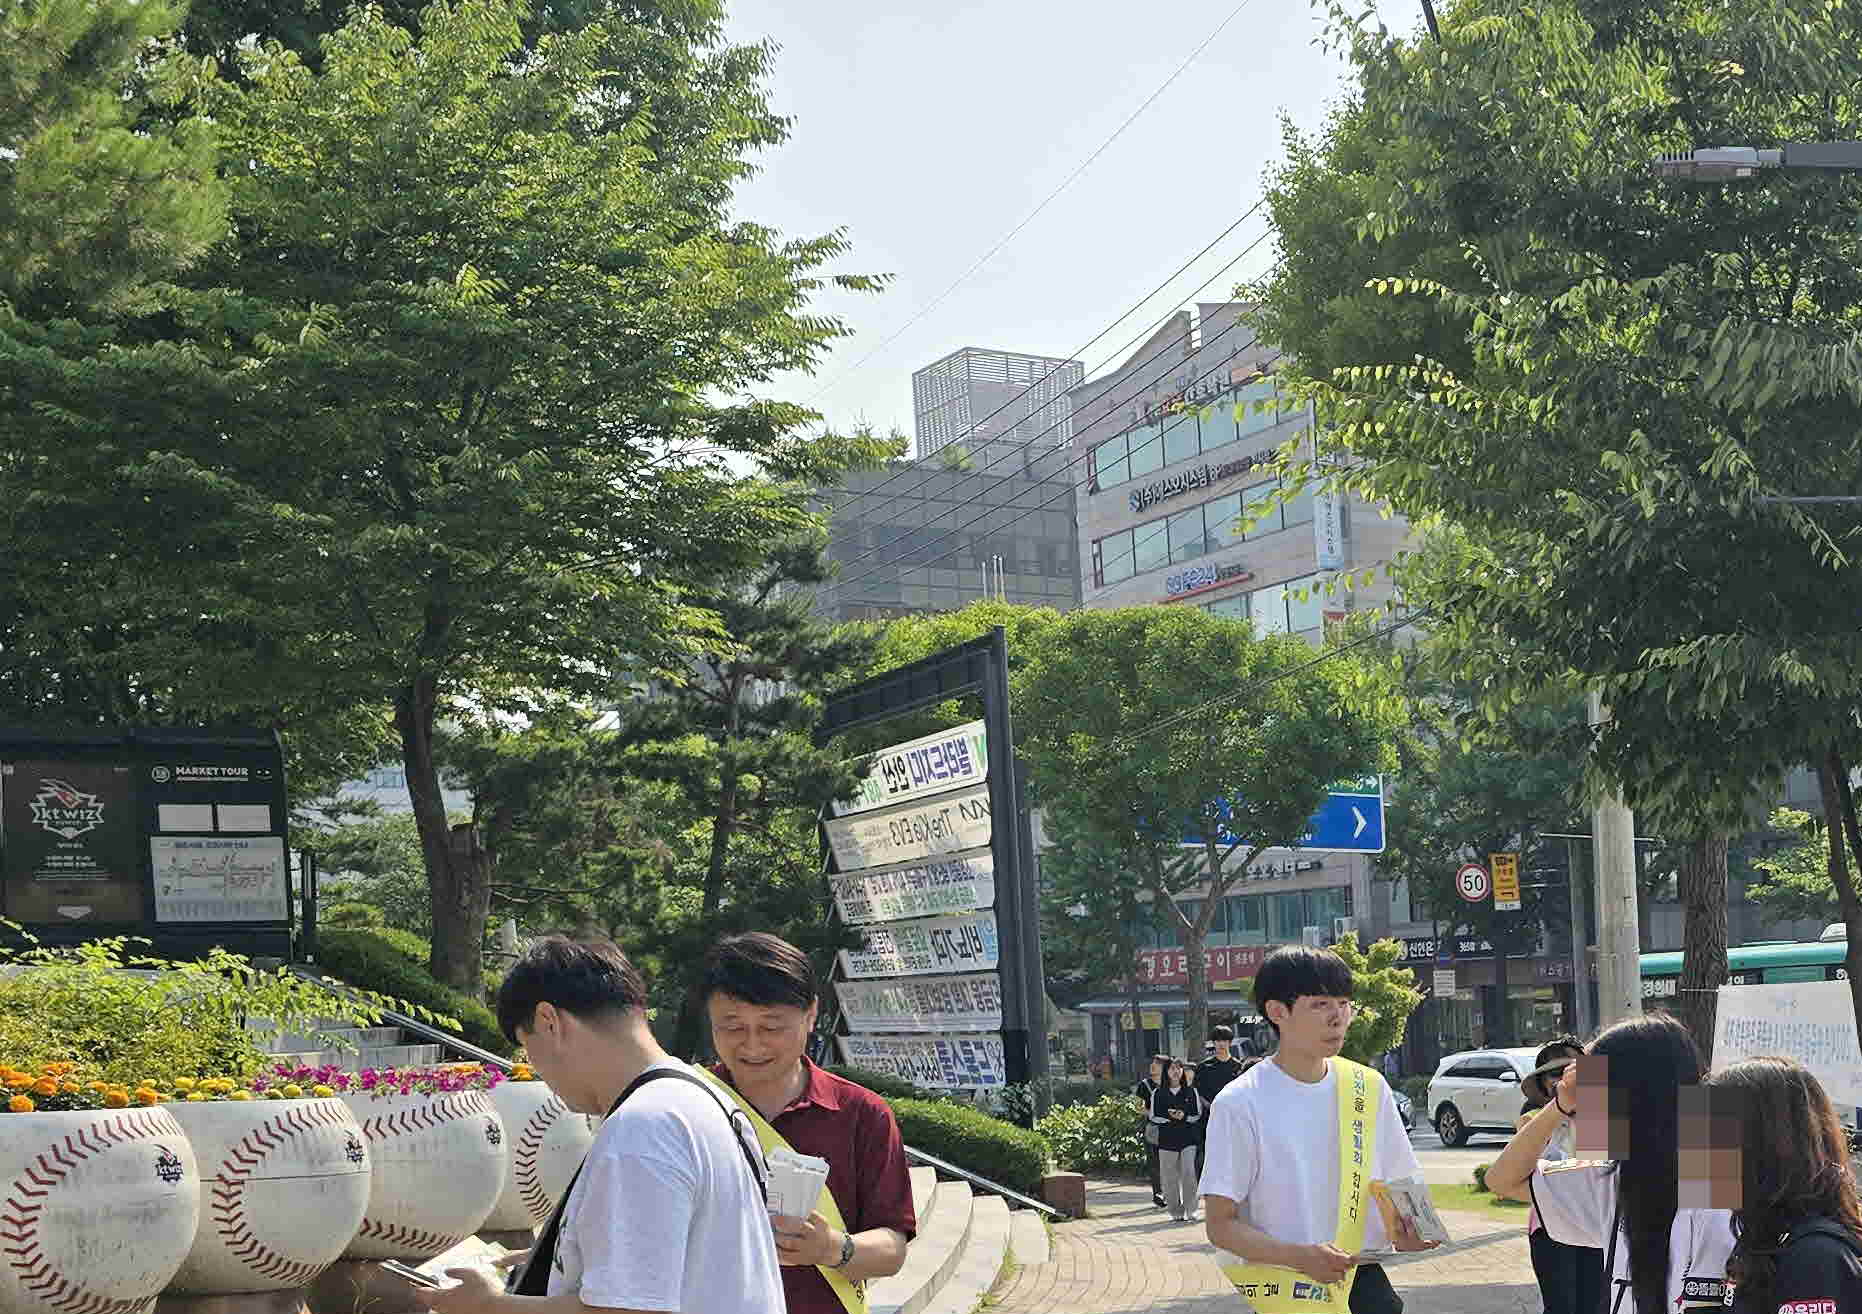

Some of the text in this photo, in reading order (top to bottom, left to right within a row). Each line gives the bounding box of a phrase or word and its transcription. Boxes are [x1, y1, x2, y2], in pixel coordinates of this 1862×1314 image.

[175, 766, 249, 777] MARKET TOUR
[1463, 875, 1484, 891] 50
